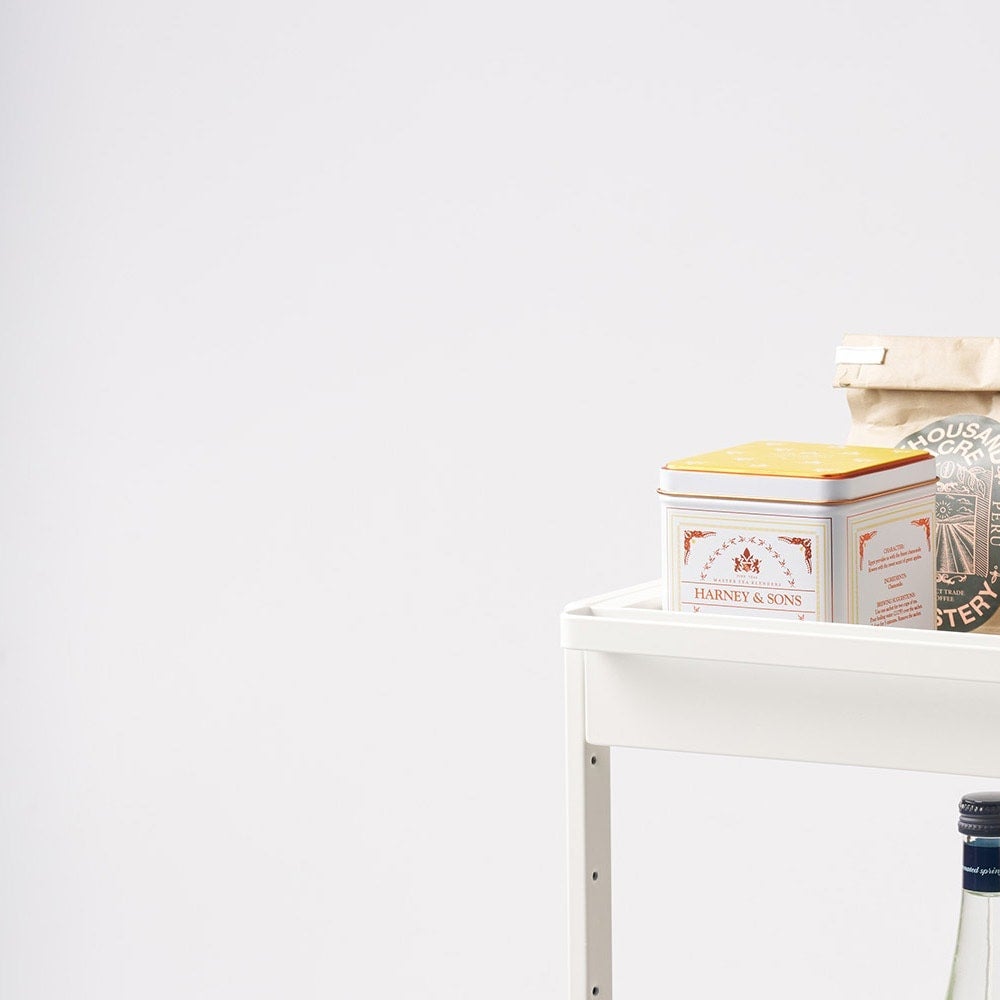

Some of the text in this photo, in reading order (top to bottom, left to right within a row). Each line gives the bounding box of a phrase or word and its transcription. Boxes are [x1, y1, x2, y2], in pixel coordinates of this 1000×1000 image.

[695, 588, 802, 606] HARNEY & SONS
[937, 580, 998, 627] STERY
